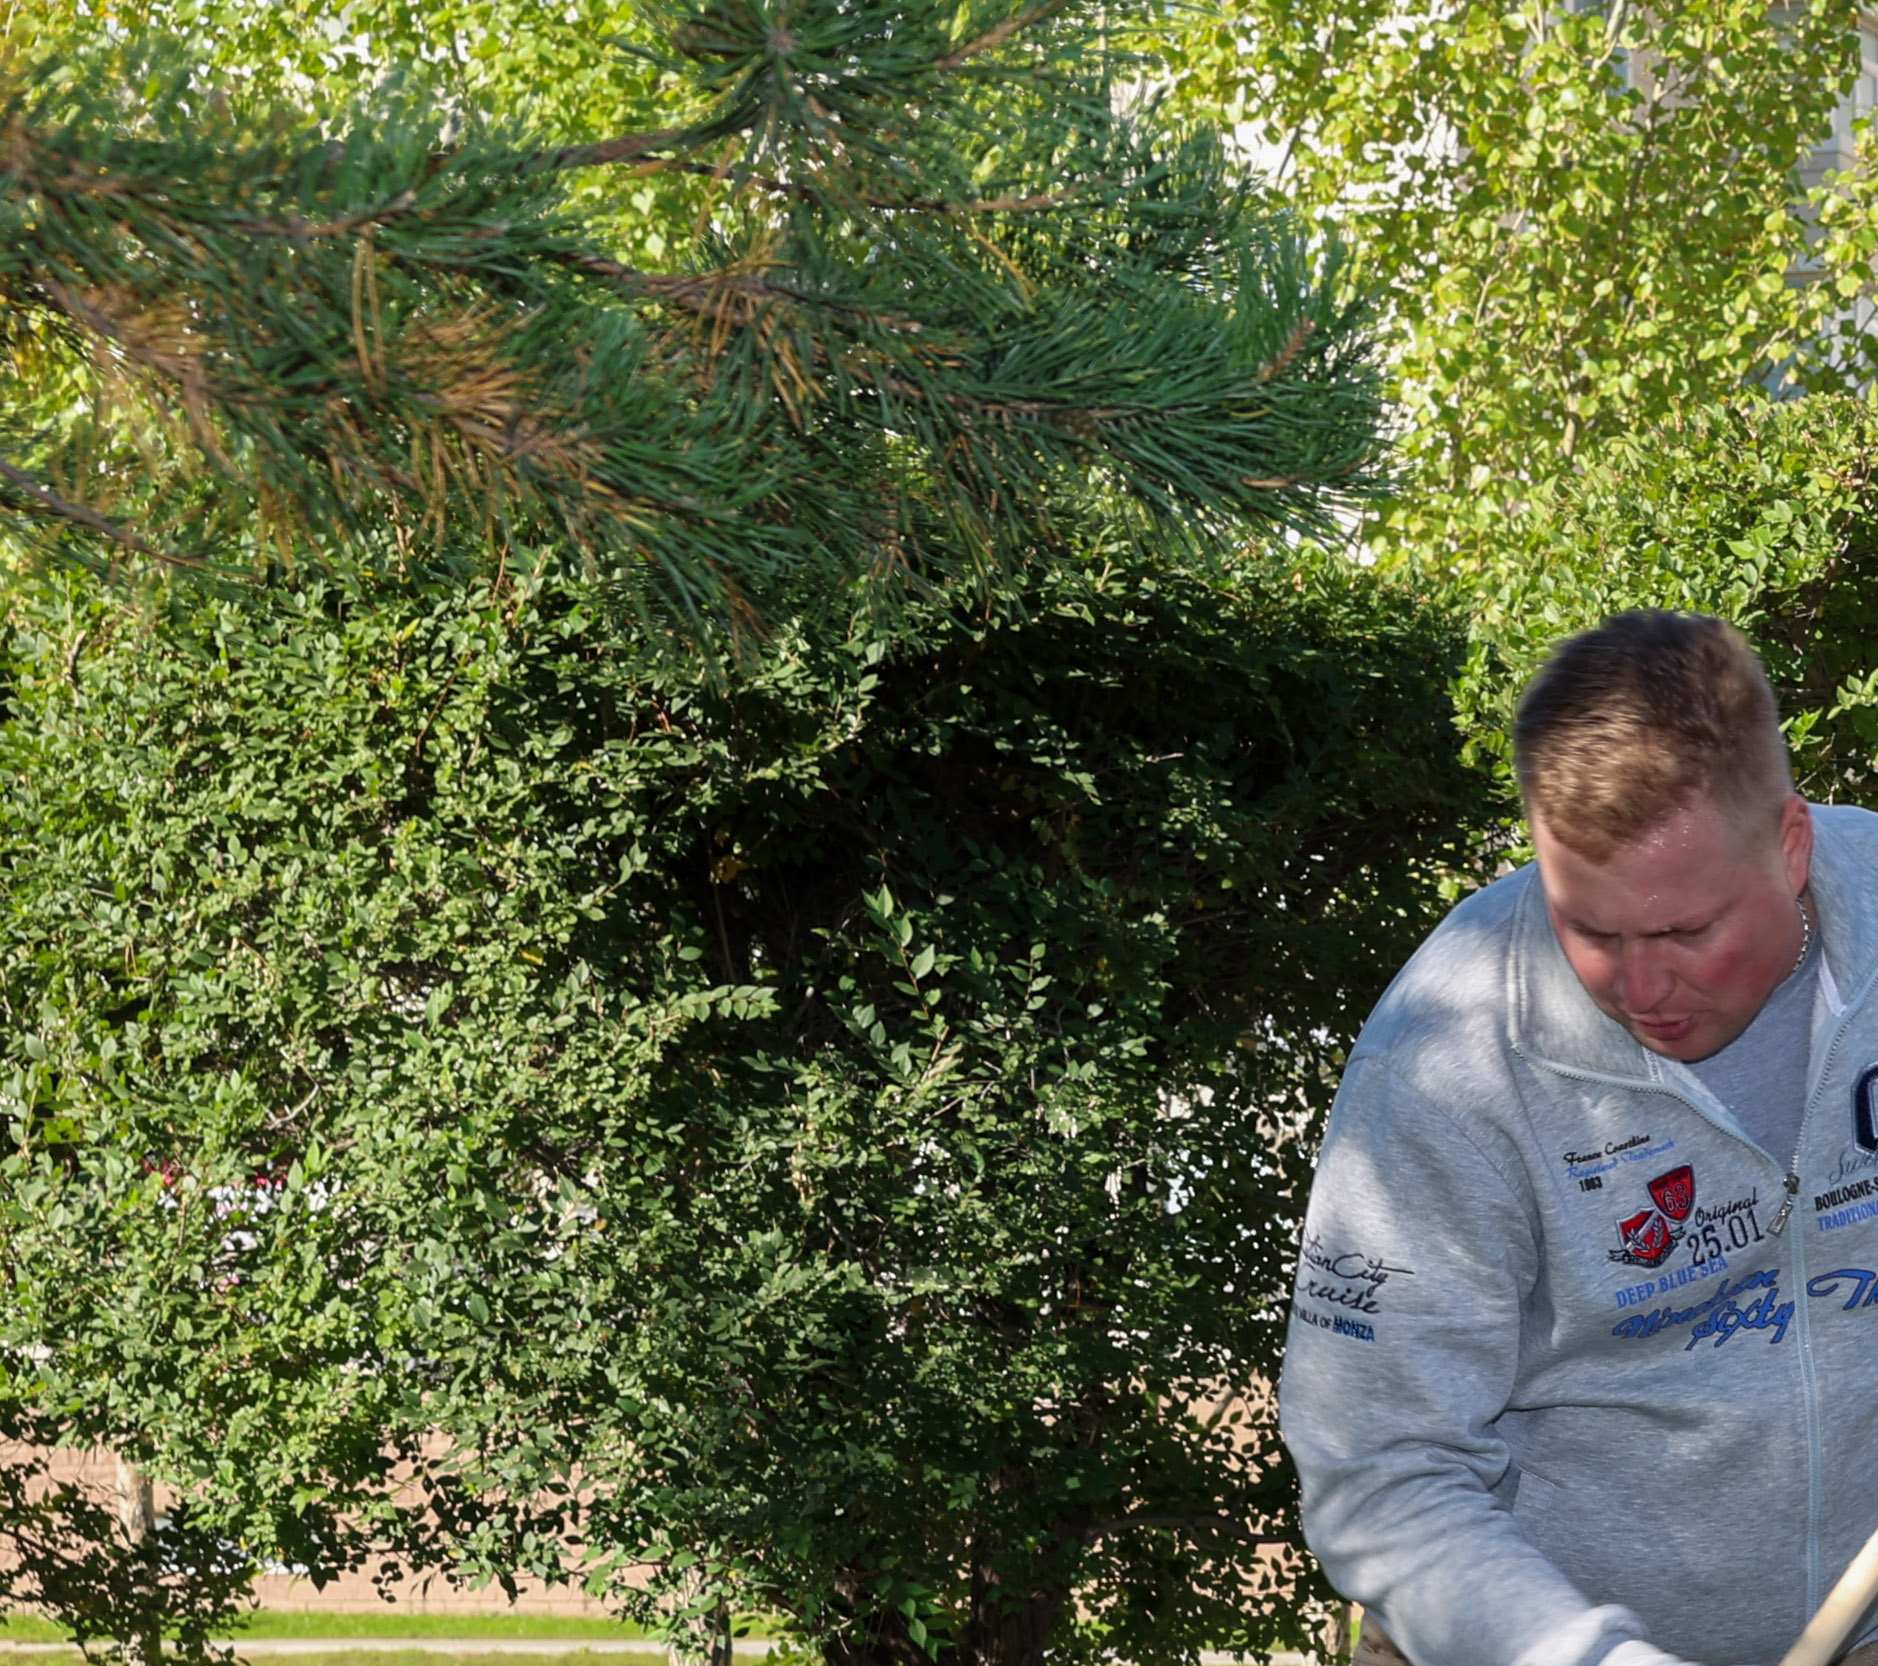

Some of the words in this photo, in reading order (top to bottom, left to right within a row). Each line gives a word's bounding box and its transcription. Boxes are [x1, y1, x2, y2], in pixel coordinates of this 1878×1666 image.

[1694, 1187, 1759, 1228] Original
[1687, 1210, 1765, 1267] 25.01
[1332, 1253, 1416, 1298] City
[1615, 1282, 1656, 1310] DEEP
[1659, 1263, 1697, 1293] BLUE
[1701, 1254, 1729, 1279] SEA
[1332, 1315, 1375, 1342] MONZA
[1684, 1288, 1796, 1351] Sixty
